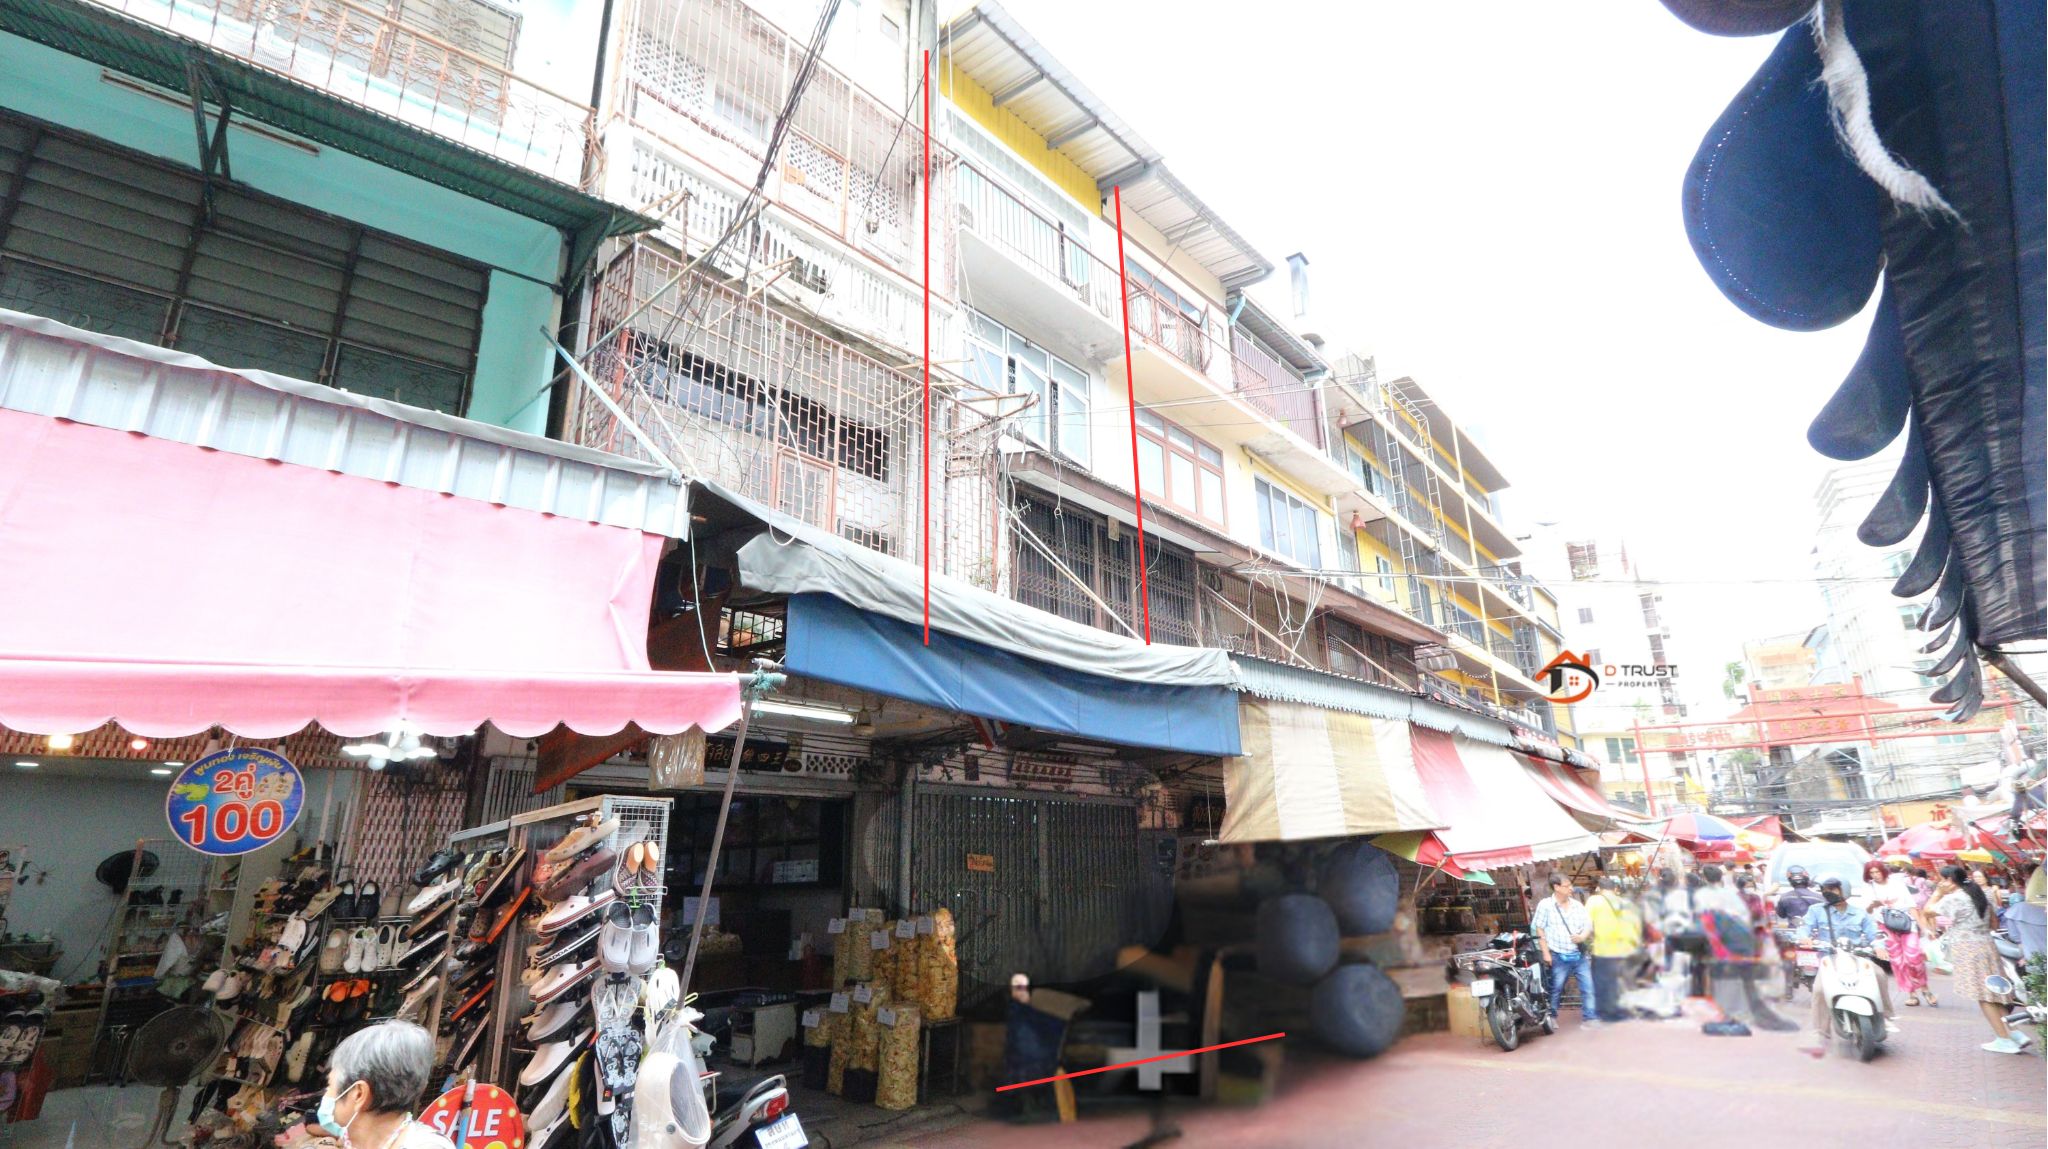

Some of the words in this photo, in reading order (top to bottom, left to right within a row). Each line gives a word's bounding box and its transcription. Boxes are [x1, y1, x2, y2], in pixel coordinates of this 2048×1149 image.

[213, 762, 256, 801] 2คู่
[181, 799, 284, 846] 100
[432, 1108, 503, 1138] SALE
